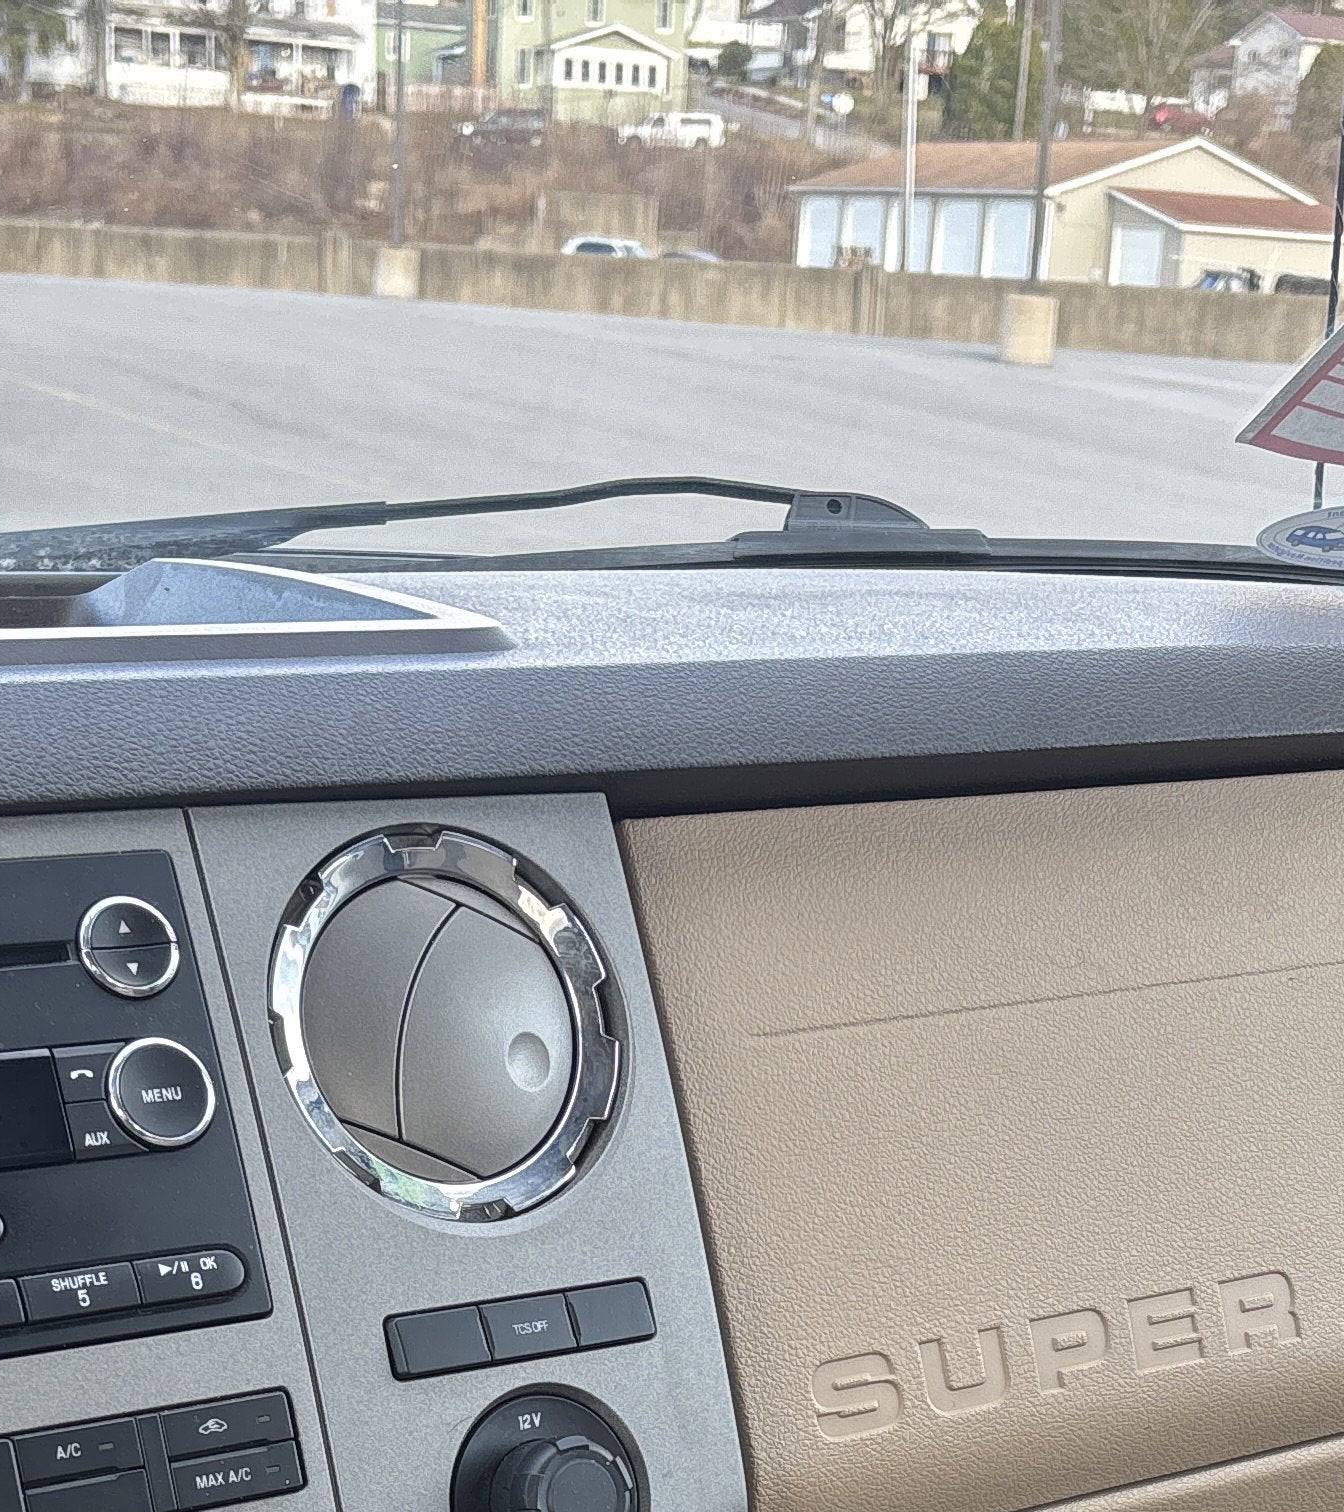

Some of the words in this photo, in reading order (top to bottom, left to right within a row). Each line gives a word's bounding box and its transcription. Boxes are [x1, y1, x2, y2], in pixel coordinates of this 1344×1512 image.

[141, 1086, 182, 1104] MENU
[84, 1132, 111, 1147] AUX
[199, 1257, 218, 1271] OK
[51, 1272, 109, 1292] SHUFFLE
[191, 1274, 203, 1290] 6
[77, 1288, 90, 1308] 5
[812, 1269, 1302, 1444] SUPER
[518, 1411, 542, 1430] 12V
[57, 1442, 82, 1461] A/C
[196, 1471, 225, 1490] MAX
[227, 1465, 252, 1485] A/C
